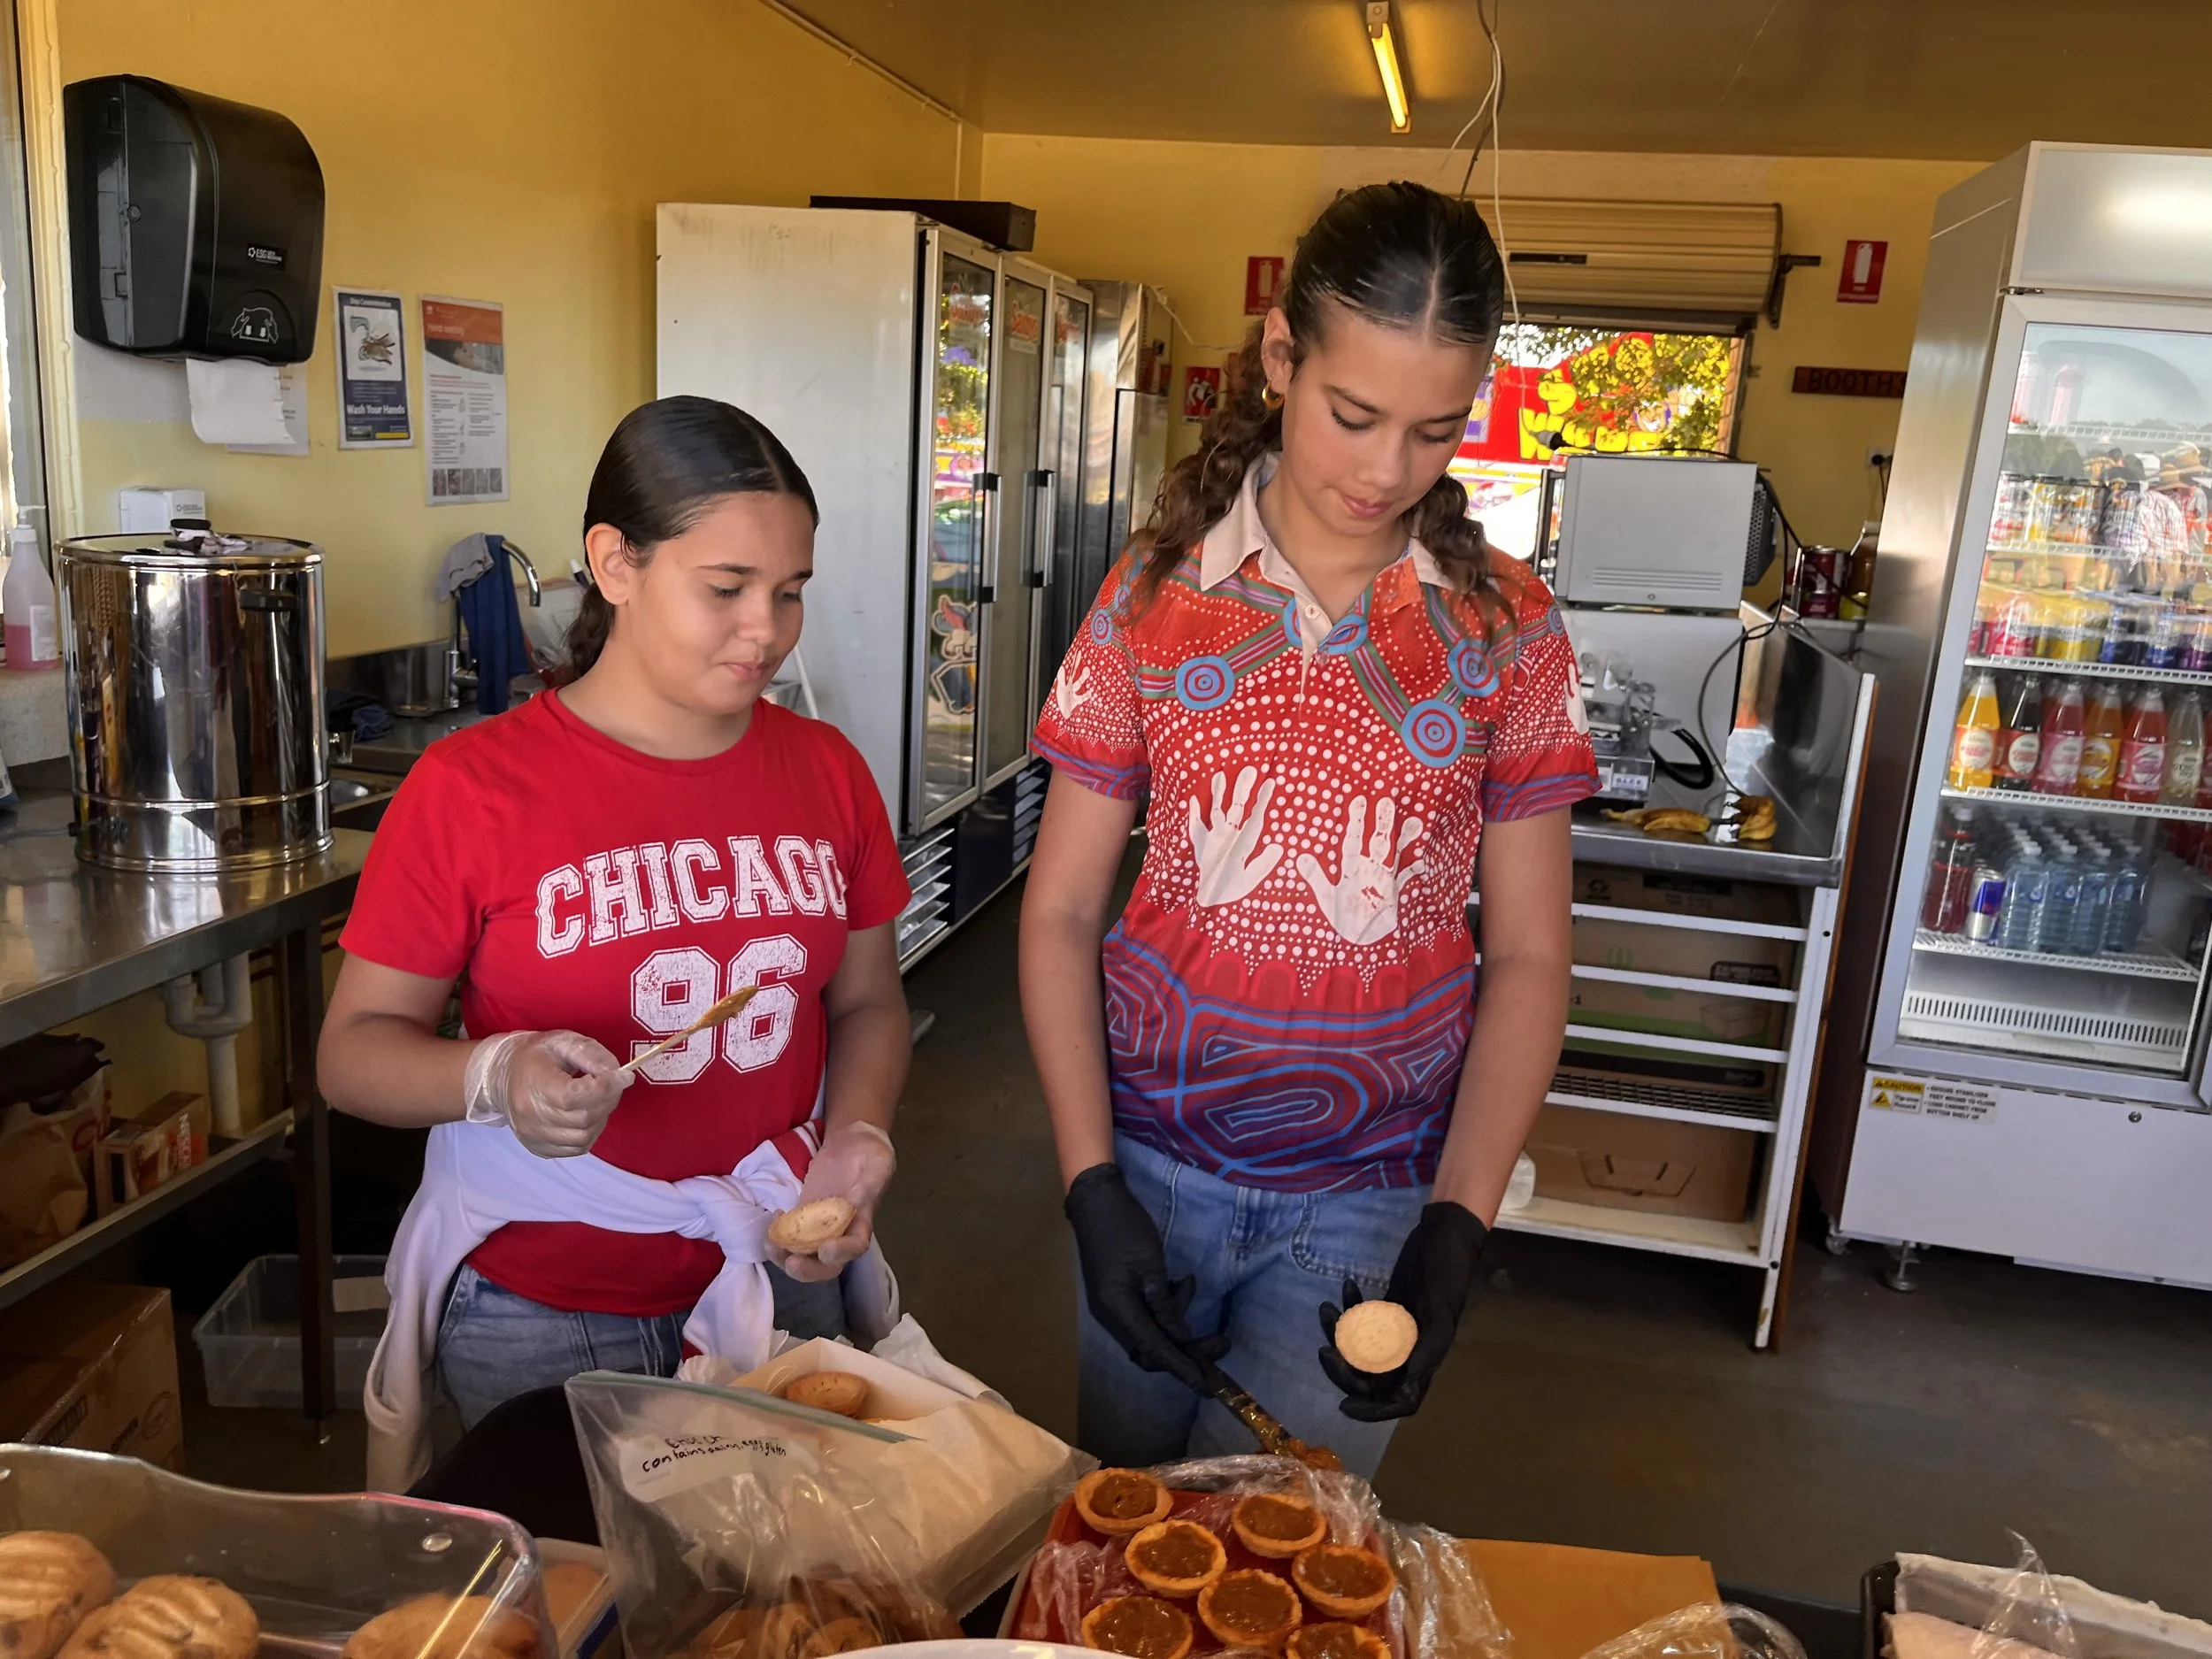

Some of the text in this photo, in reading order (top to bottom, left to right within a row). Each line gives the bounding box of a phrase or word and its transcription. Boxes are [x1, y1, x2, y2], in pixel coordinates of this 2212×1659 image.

[346, 403, 405, 414] Wash Your Hands
[536, 835, 848, 958] CHICAGO
[629, 933, 808, 1085] 96
[1883, 1079, 1923, 1092] CAUTION
[642, 1447, 706, 1472] contains
